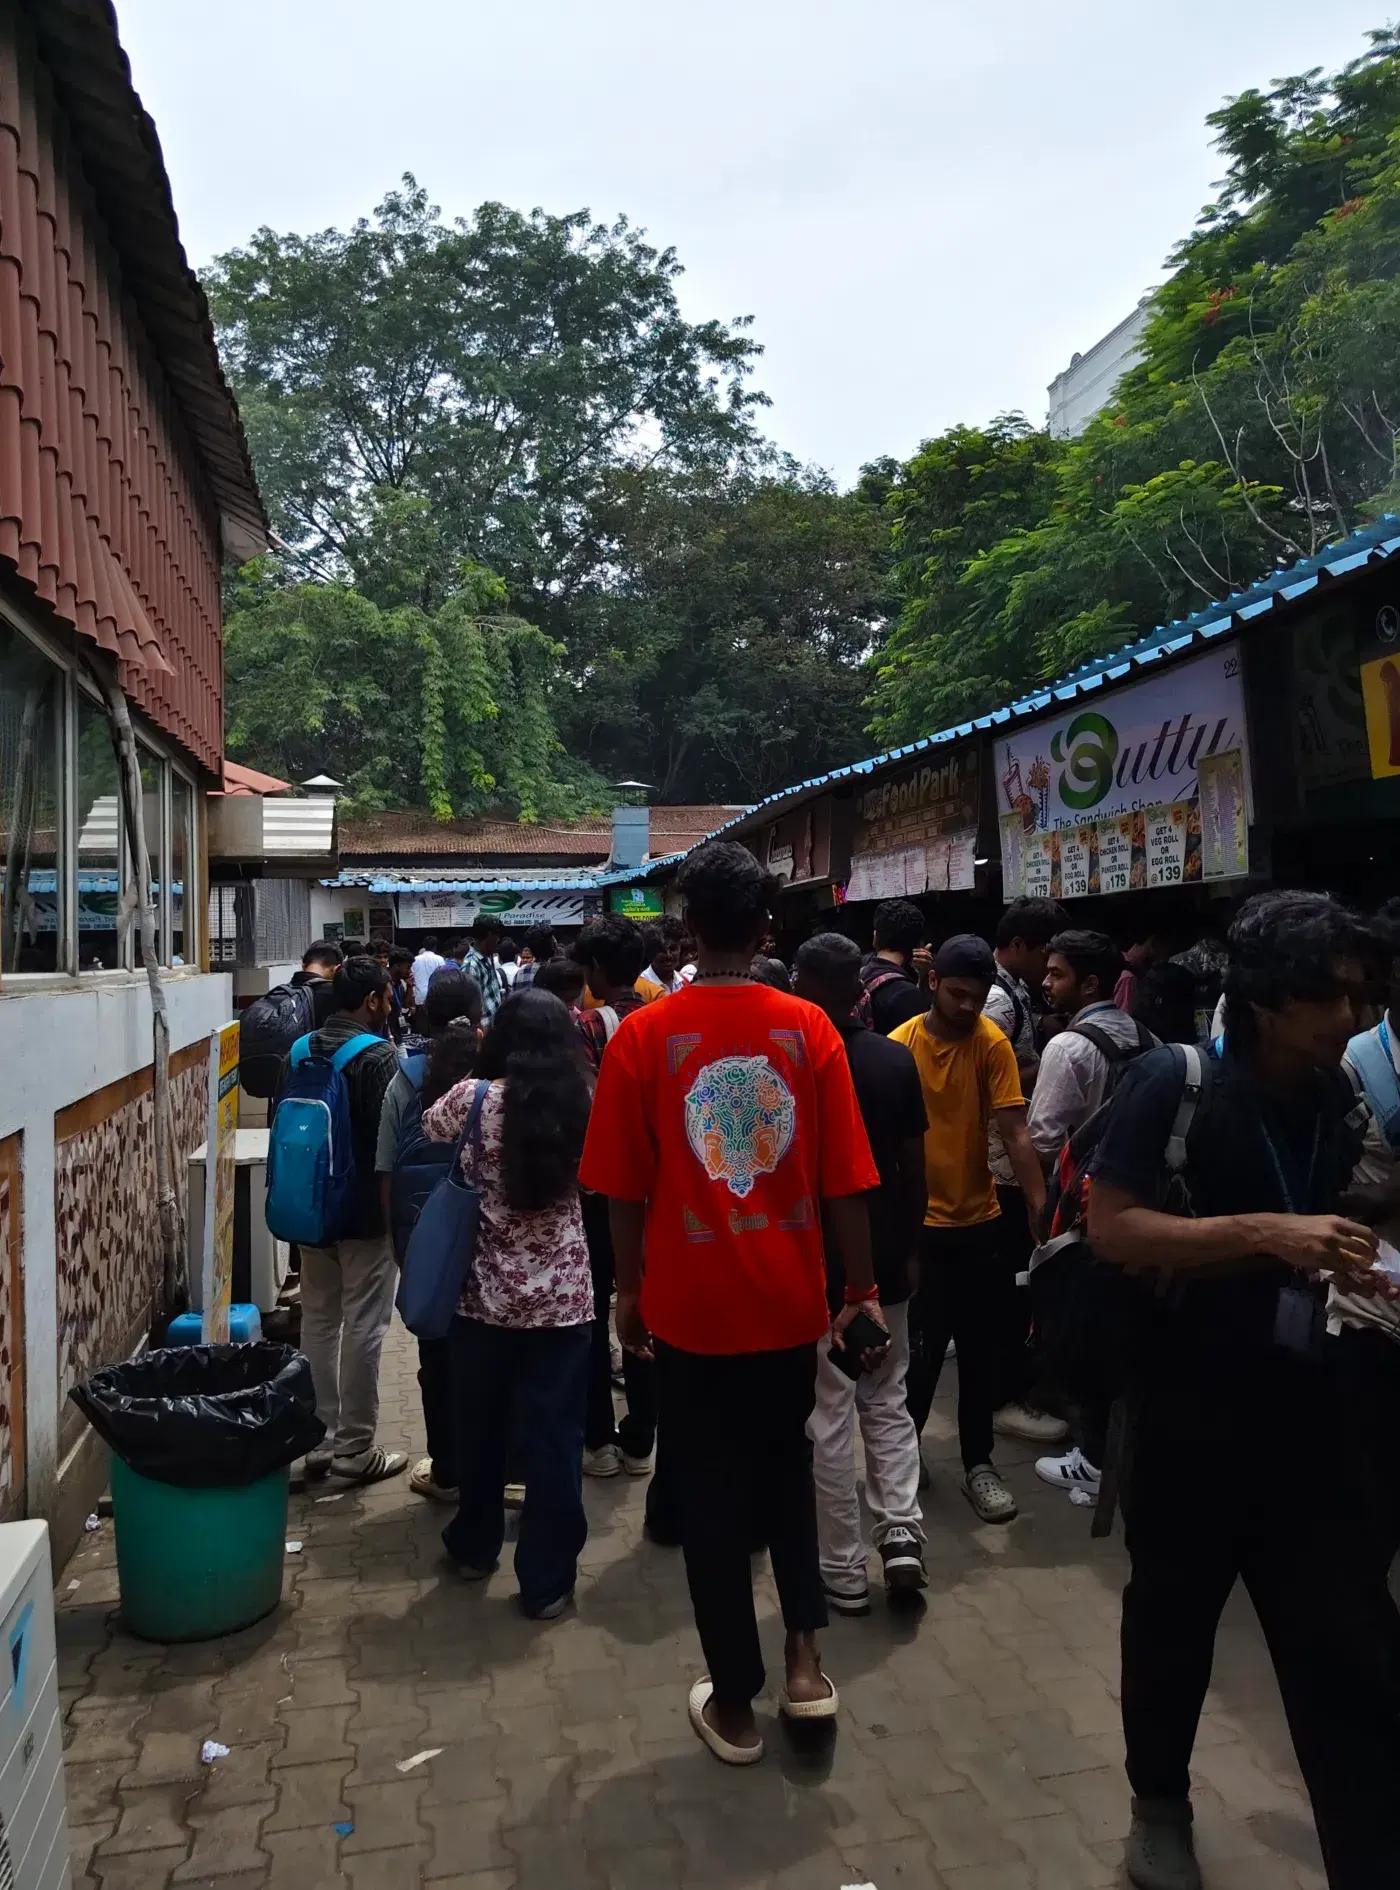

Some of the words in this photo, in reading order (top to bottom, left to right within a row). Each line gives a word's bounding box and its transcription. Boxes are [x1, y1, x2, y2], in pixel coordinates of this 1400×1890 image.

[1224, 658, 1238, 678] 22
[1053, 817, 1072, 832] The
[1156, 827, 1167, 836] GET
[1168, 825, 1172, 833] 4
[1107, 837, 1116, 846] GET
[1151, 837, 1162, 846] VEG
[1163, 835, 1179, 844] ROLL
[1067, 846, 1076, 854] GET
[1100, 847, 1117, 856] CHICKEN
[1118, 844, 1129, 852] ROLL
[1161, 846, 1169, 855] OR
[1073, 853, 1084, 861] ROLL
[1111, 855, 1118, 864] OR
[1151, 857, 1163, 866] EGG
[1164, 855, 1180, 864] ROLL
[1101, 865, 1117, 874] PANEER
[1118, 863, 1129, 872] ROLL
[1073, 870, 1085, 879] ROLL
